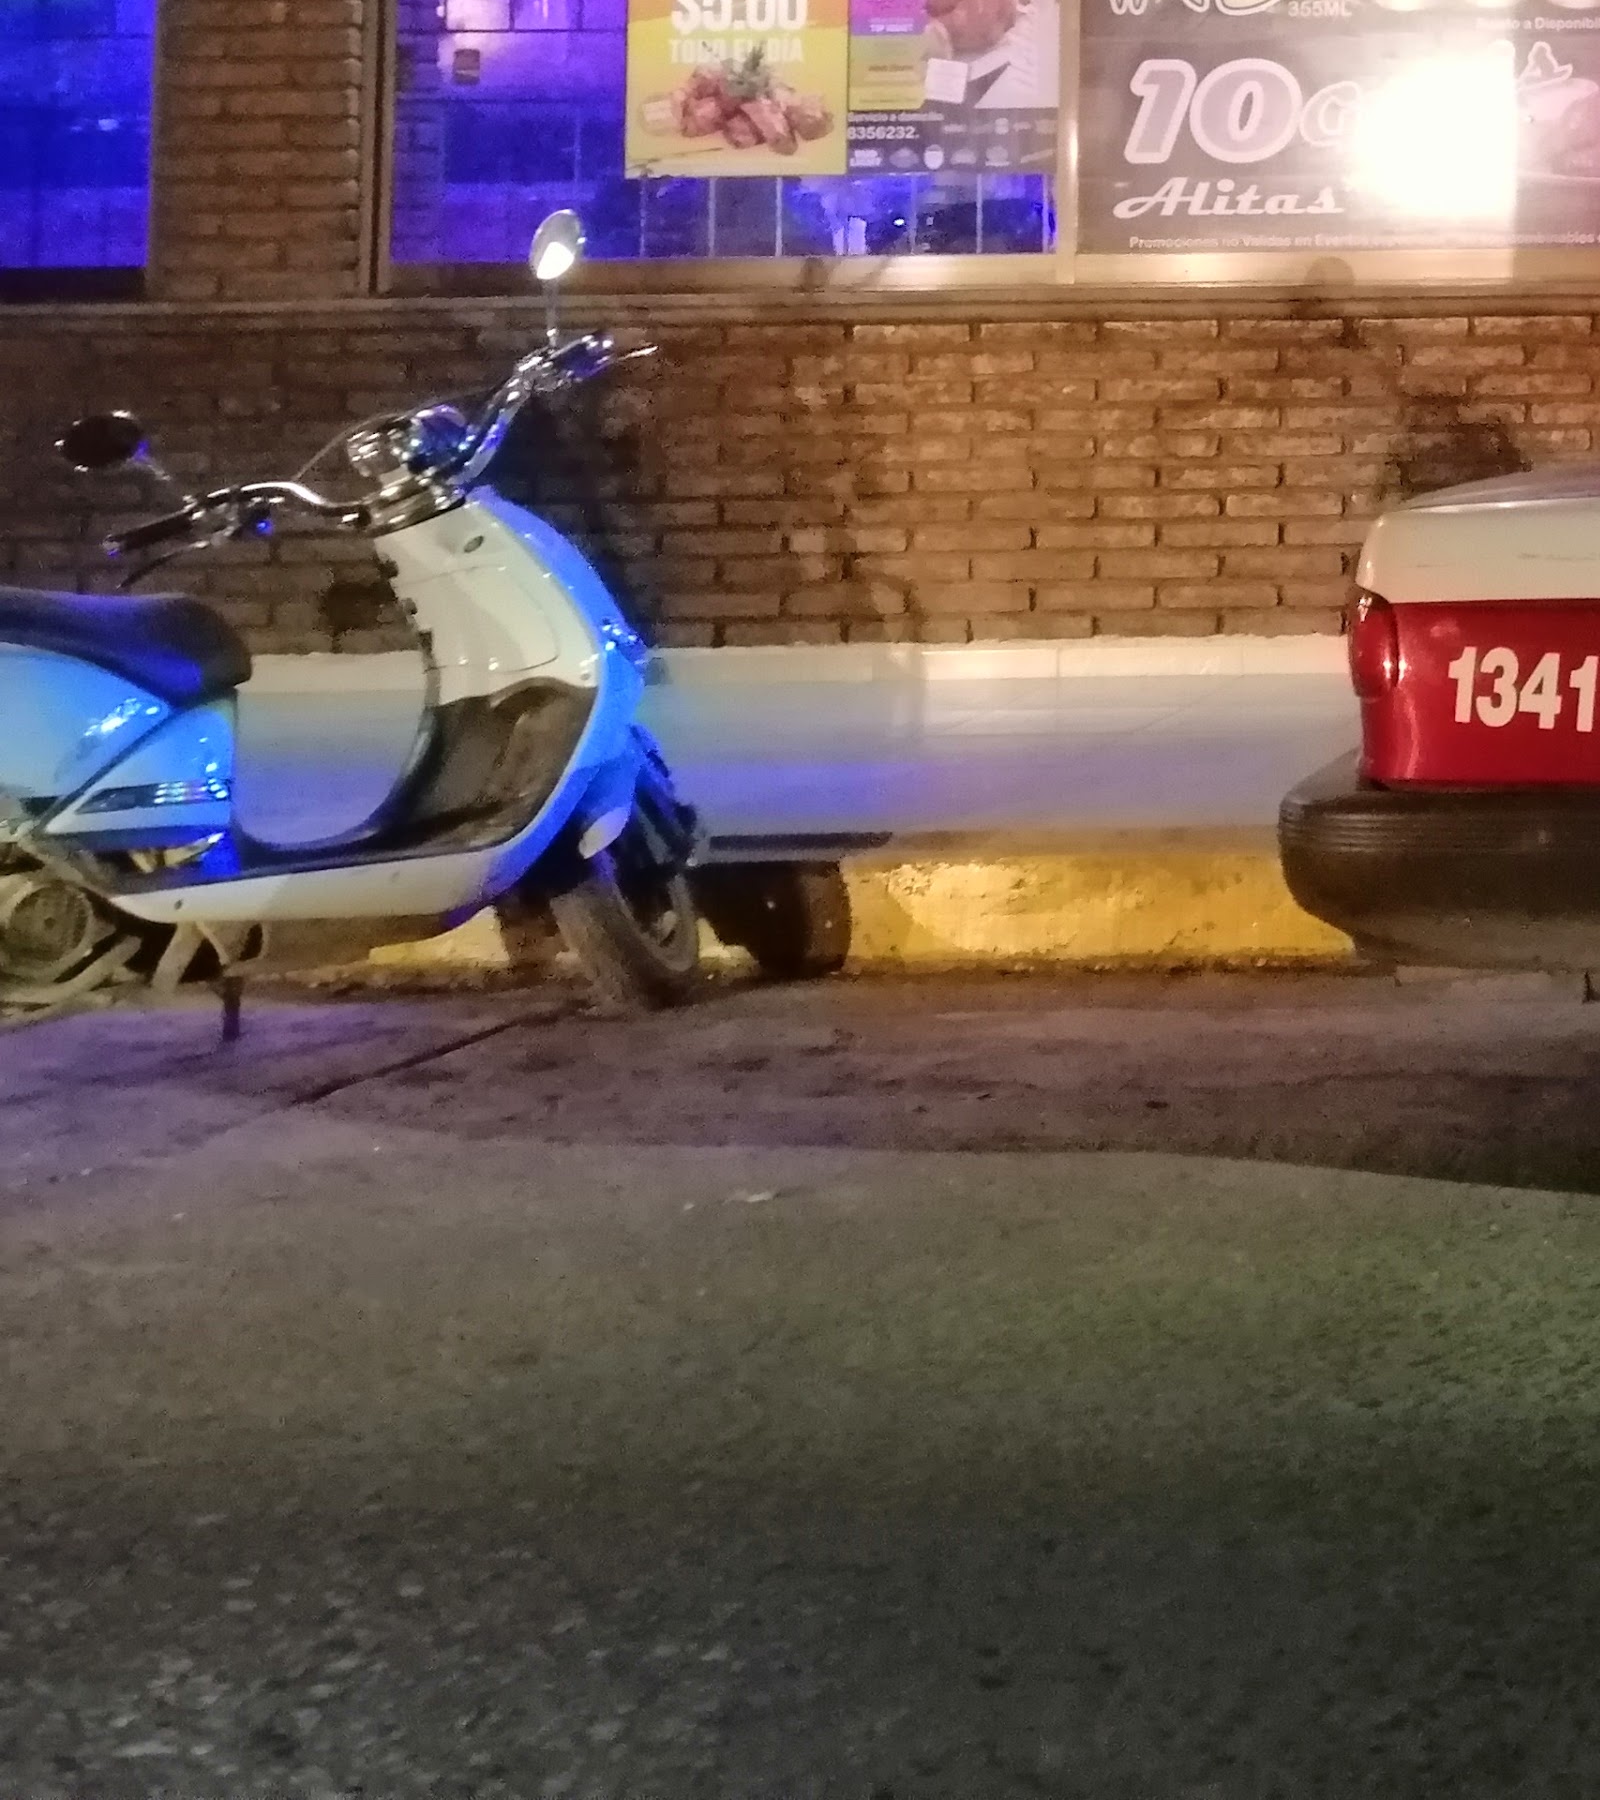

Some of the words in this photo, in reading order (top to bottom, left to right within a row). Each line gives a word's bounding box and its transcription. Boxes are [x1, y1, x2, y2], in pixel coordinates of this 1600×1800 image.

[1287, 0, 1352, 19] 355ML
[1123, 57, 1303, 164] 10
[1112, 175, 1347, 220] Alitas
[1448, 645, 1600, 733] 1341
